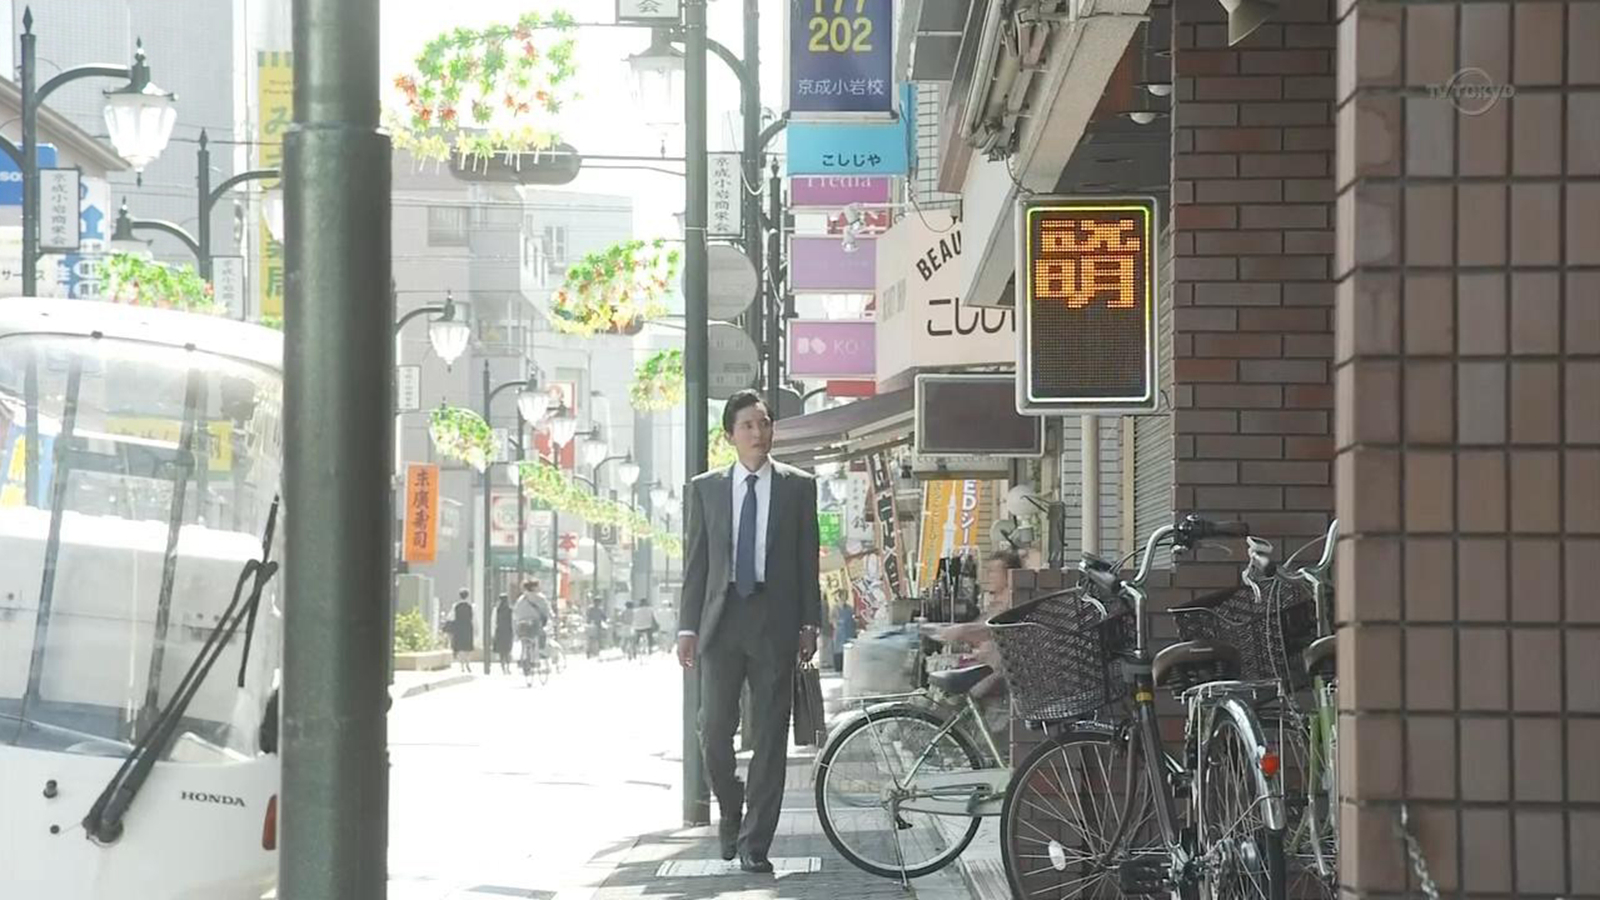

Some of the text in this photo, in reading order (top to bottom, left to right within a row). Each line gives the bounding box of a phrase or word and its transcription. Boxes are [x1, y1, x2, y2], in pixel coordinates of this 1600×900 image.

[808, 16, 872, 52] 202
[798, 79, 885, 97] 京成小岩校
[822, 153, 882, 168] こしじや
[181, 791, 246, 807] HONDA
